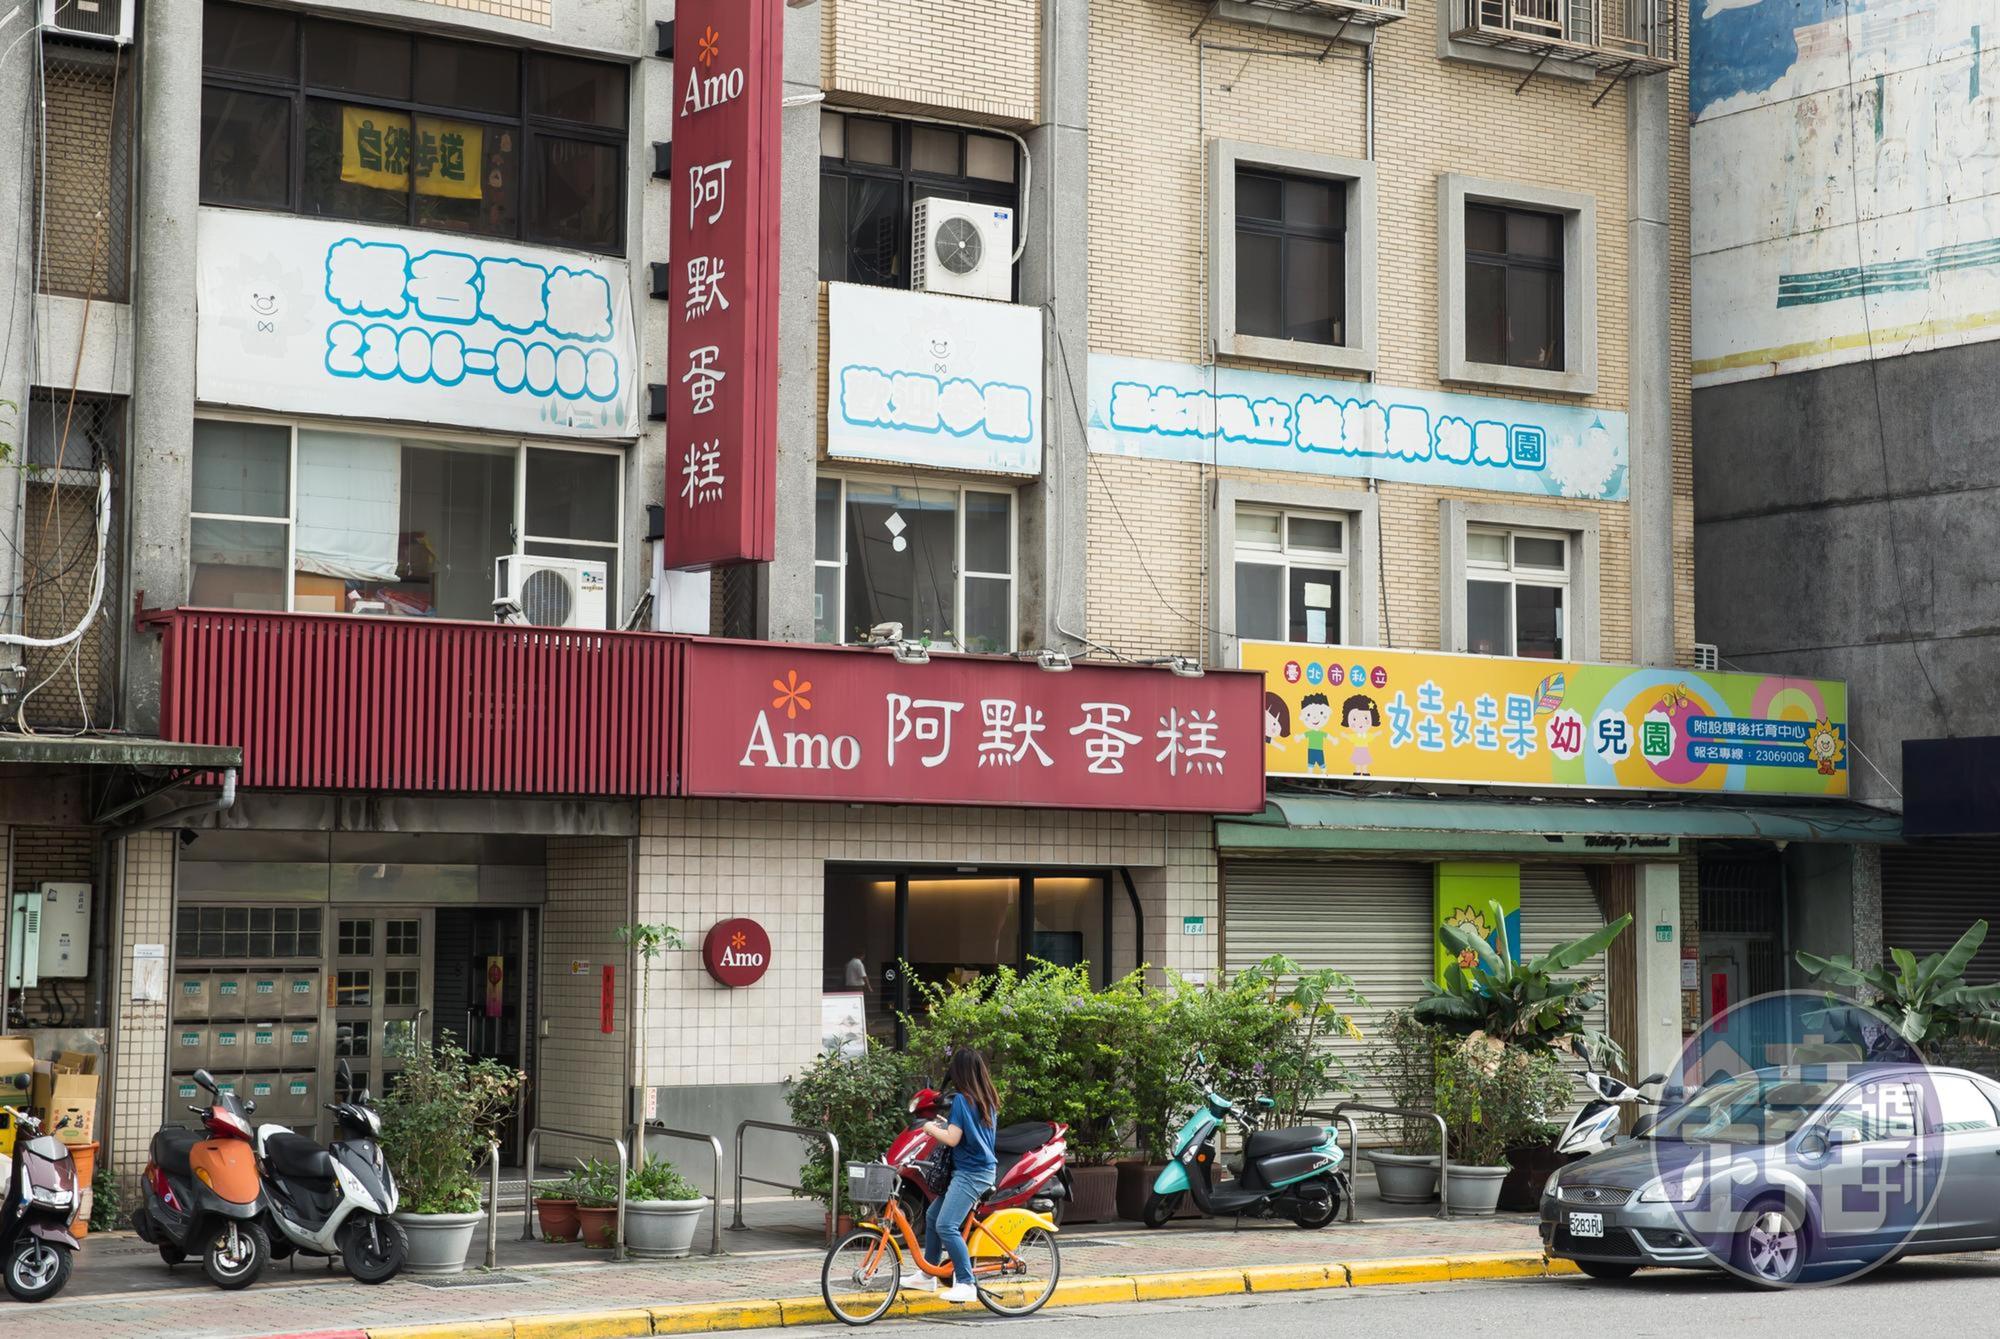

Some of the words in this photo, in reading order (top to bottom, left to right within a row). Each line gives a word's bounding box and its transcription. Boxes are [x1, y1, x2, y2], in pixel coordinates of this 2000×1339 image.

[681, 67, 743, 117] Amo
[357, 119, 466, 182] 自然步道
[681, 159, 732, 508] 阿默蛋糕
[1285, 663, 1387, 685] 臺北市私立
[739, 709, 861, 770] Amo
[886, 693, 1227, 777] 阿默蛋糕
[1693, 719, 1806, 739] 附設課後托育中心
[720, 945, 764, 967] Amo
